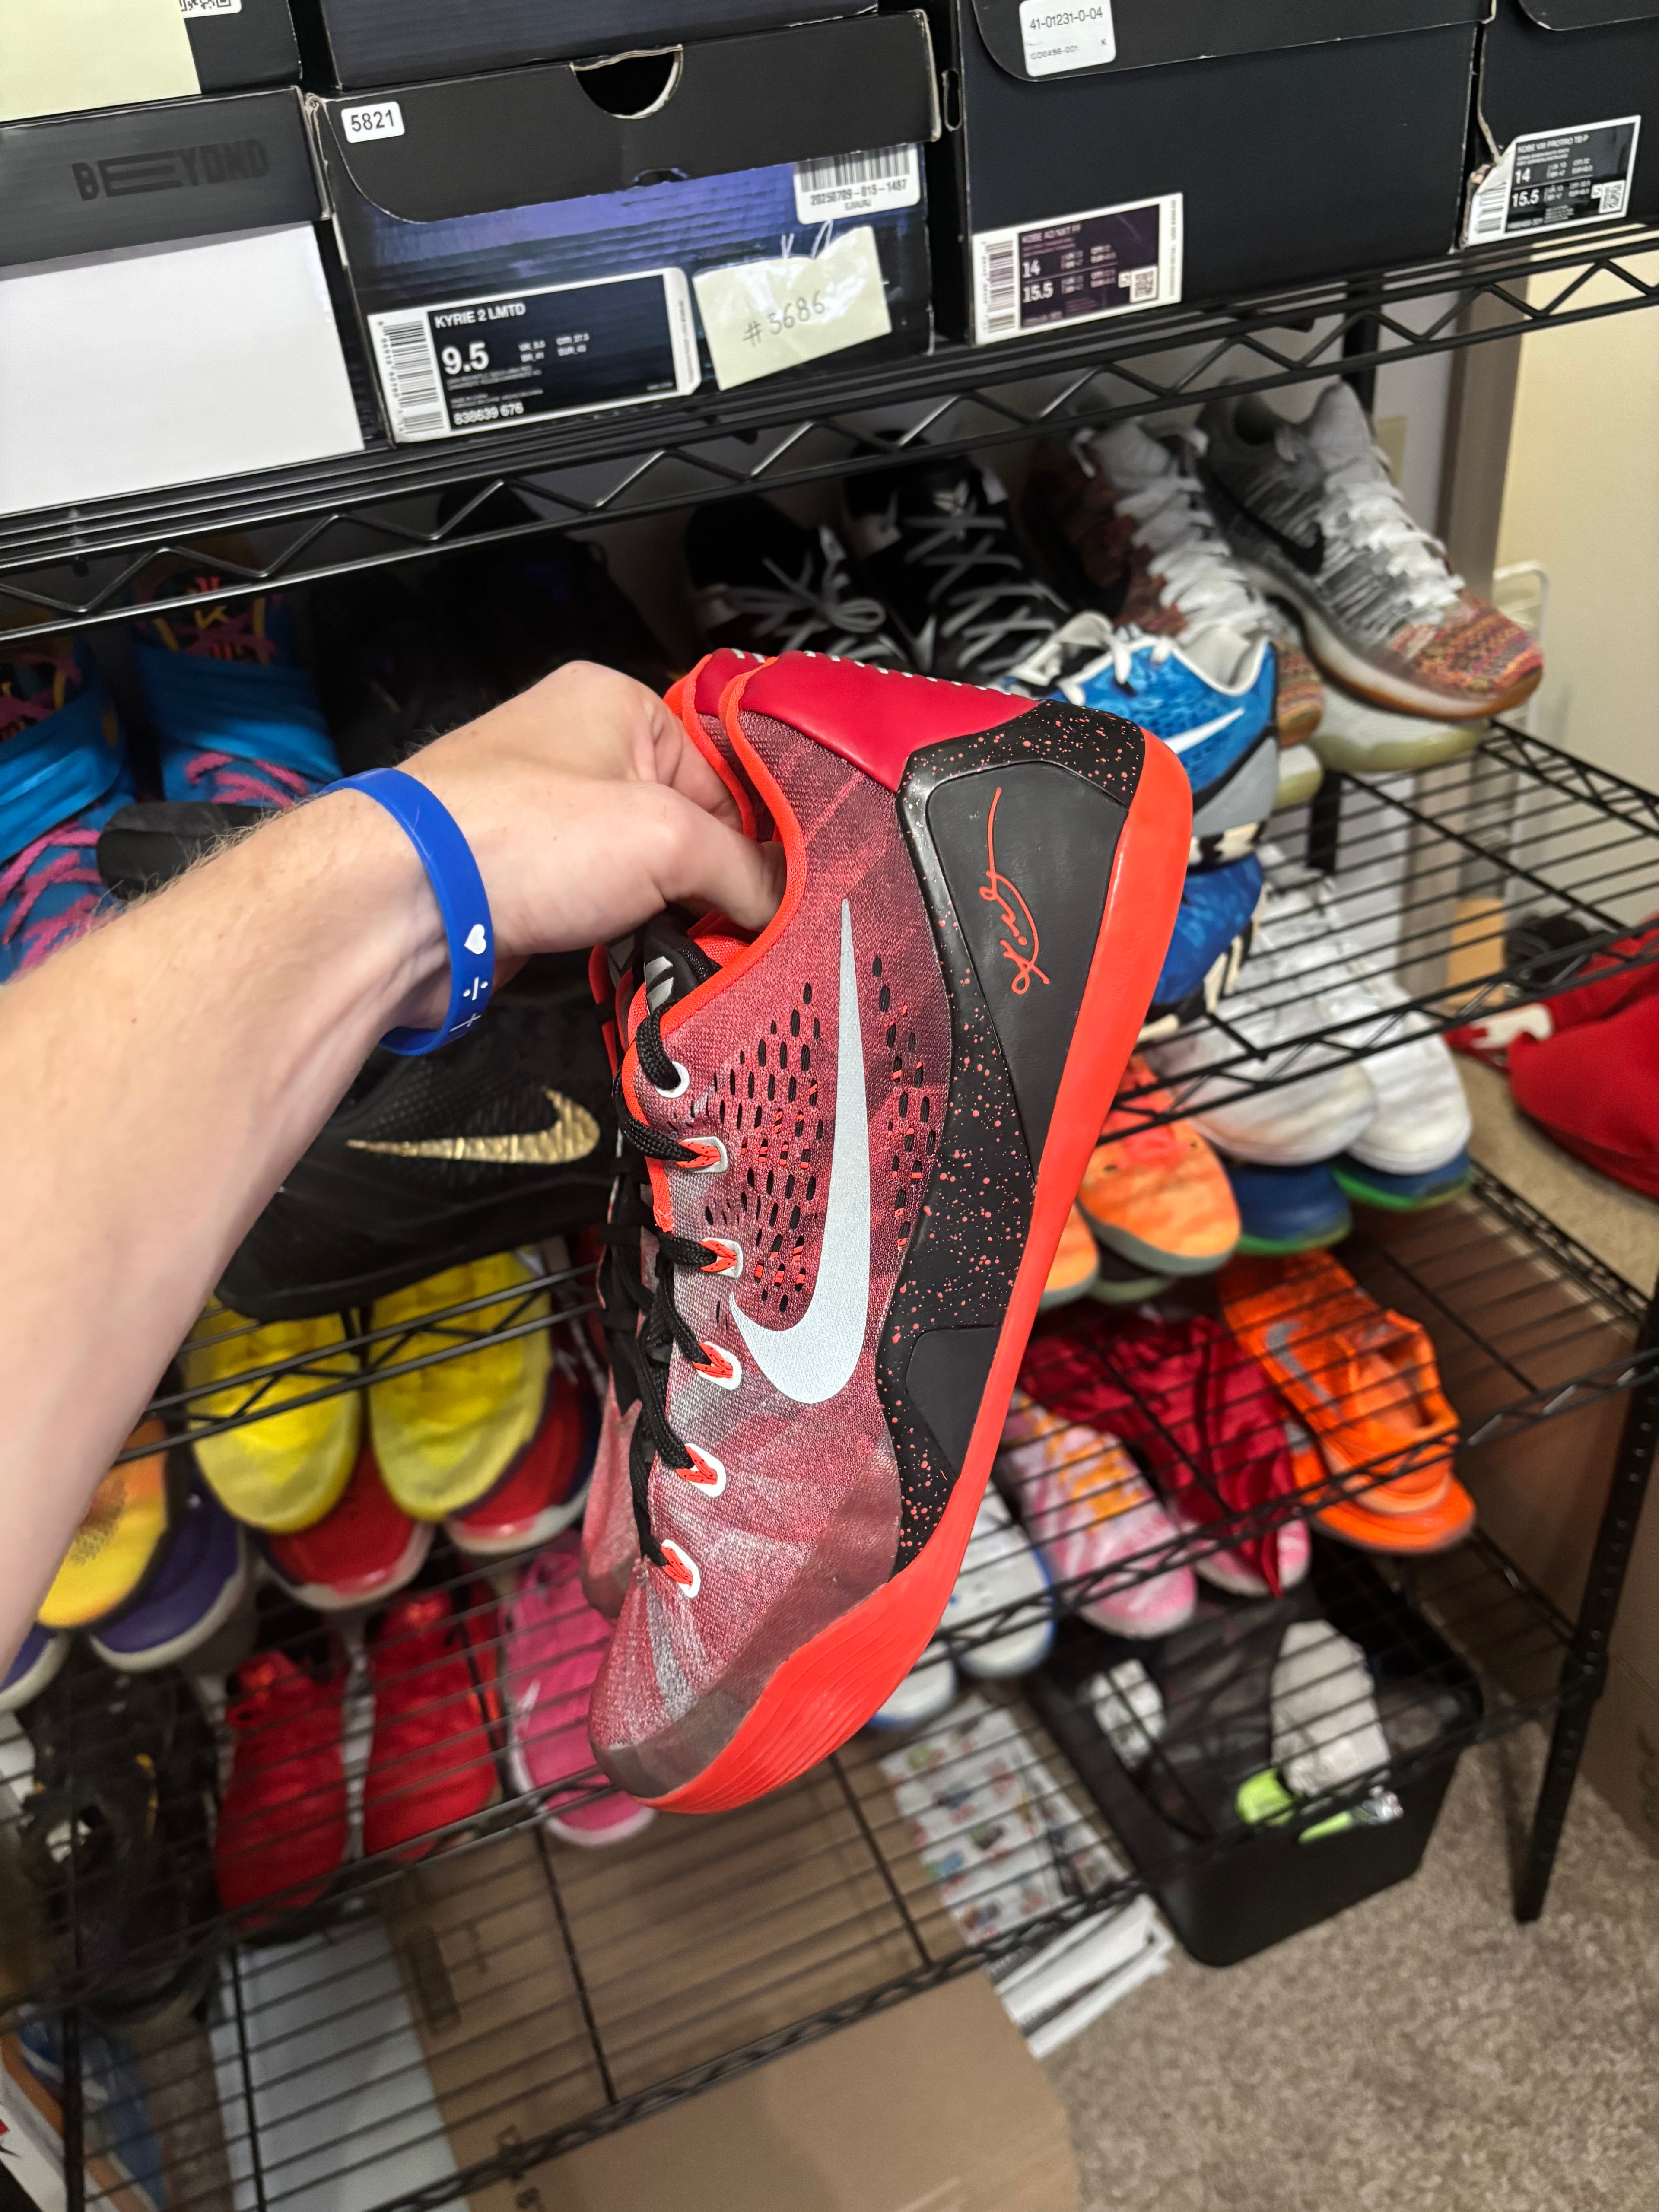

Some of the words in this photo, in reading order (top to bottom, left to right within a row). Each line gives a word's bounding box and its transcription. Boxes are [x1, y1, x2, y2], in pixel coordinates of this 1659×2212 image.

[1030, 6, 1103, 30] 41-01231-0-04
[351, 109, 394, 132] 5821
[72, 138, 268, 201] BEYOND
[1515, 168, 1531, 184] 14
[1512, 189, 1540, 208] 15.5
[1022, 259, 1041, 278] 14
[1022, 281, 1054, 303] 15.5
[434, 310, 477, 329] KYRIE
[477, 308, 487, 322] 2
[487, 302, 526, 320] LMTD
[441, 340, 489, 375] 9.5
